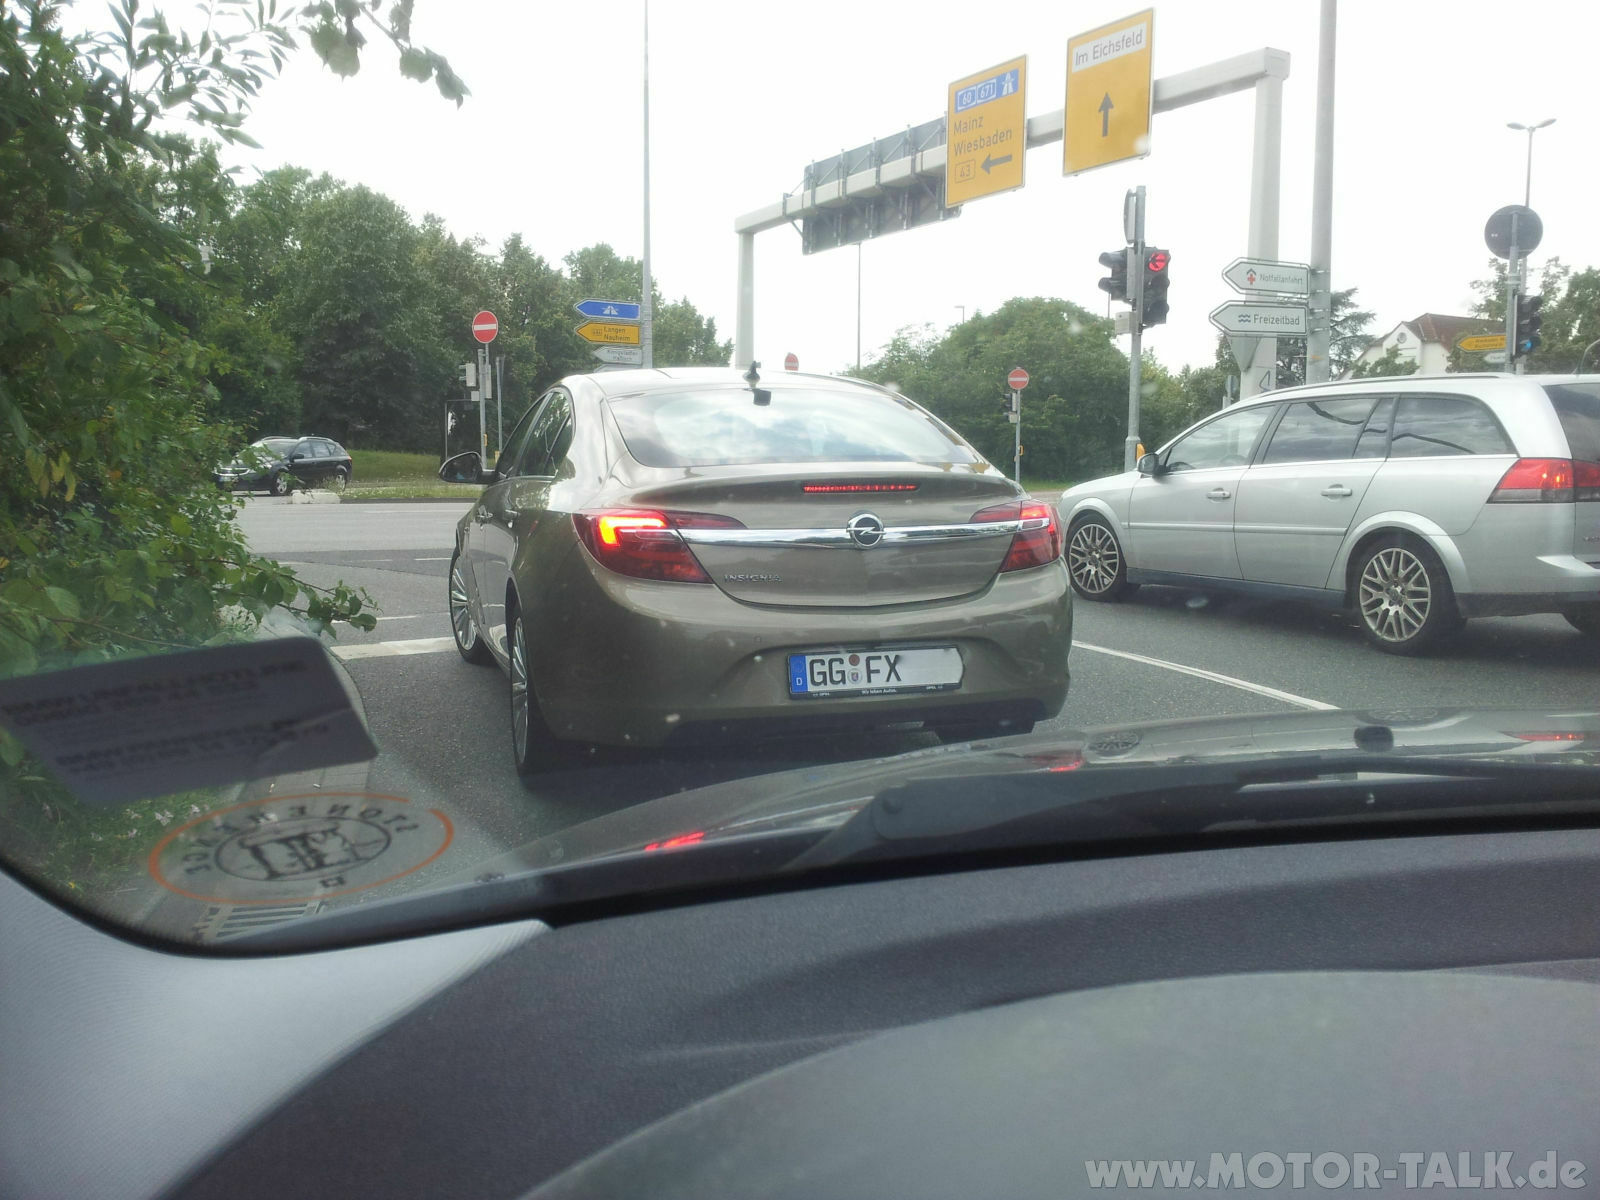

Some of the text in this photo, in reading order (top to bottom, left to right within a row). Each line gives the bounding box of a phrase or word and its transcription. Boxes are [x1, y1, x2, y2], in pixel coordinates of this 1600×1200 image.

[1075, 28, 1143, 66] Im Eichsfeld
[961, 91, 973, 105] 60
[979, 83, 994, 98] 671
[953, 115, 984, 136] Mainz
[953, 128, 1013, 157] Wiesbaden
[959, 164, 972, 179] 43
[1259, 273, 1303, 285] Notfallanfahrt
[1253, 313, 1300, 326] Freizeitbad
[723, 574, 783, 582] INSIGNIA
[809, 654, 902, 687] GG FX
[795, 677, 803, 687] D
